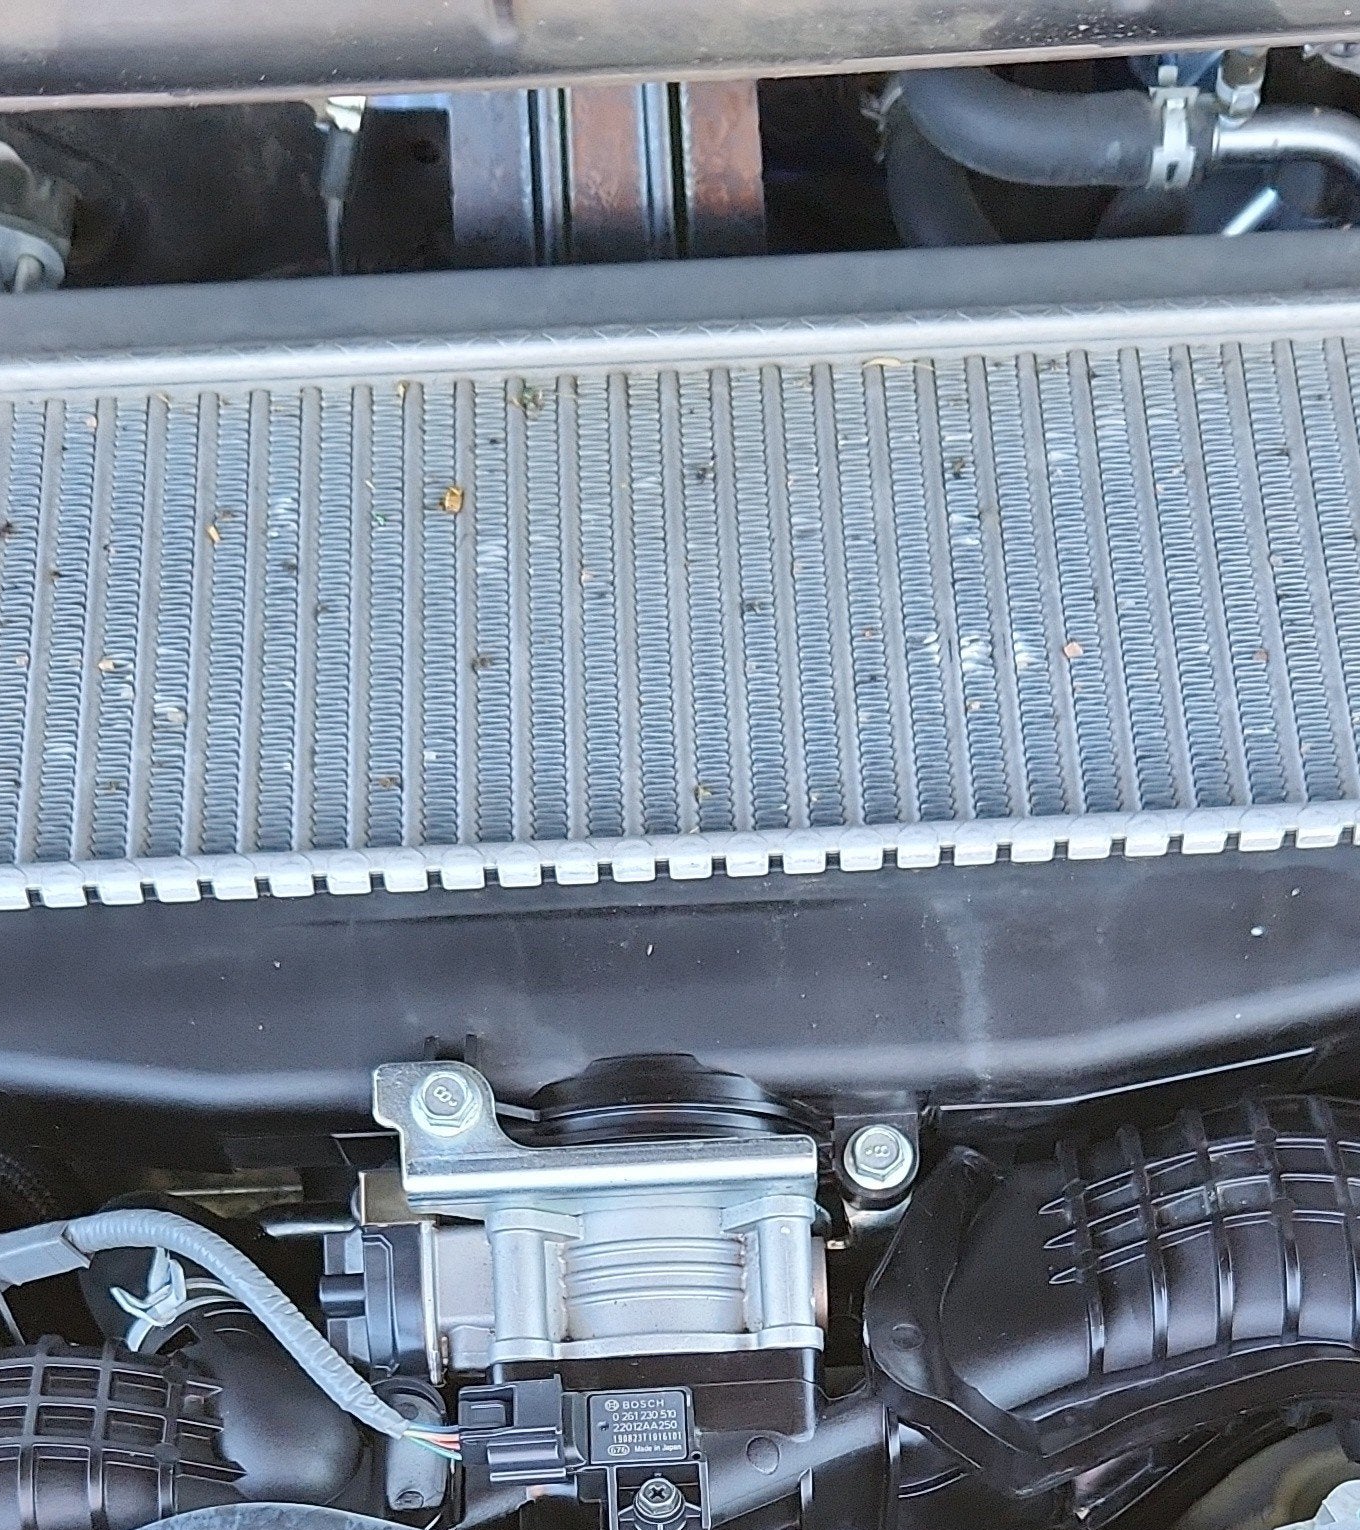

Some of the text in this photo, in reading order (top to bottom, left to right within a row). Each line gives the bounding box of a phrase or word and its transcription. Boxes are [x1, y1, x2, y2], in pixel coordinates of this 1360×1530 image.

[622, 1400, 664, 1409] BOSCH
[612, 1409, 676, 1422] 0 261 230 510
[613, 1420, 678, 1433] 22012AA250
[662, 1444, 682, 1452] Japan
